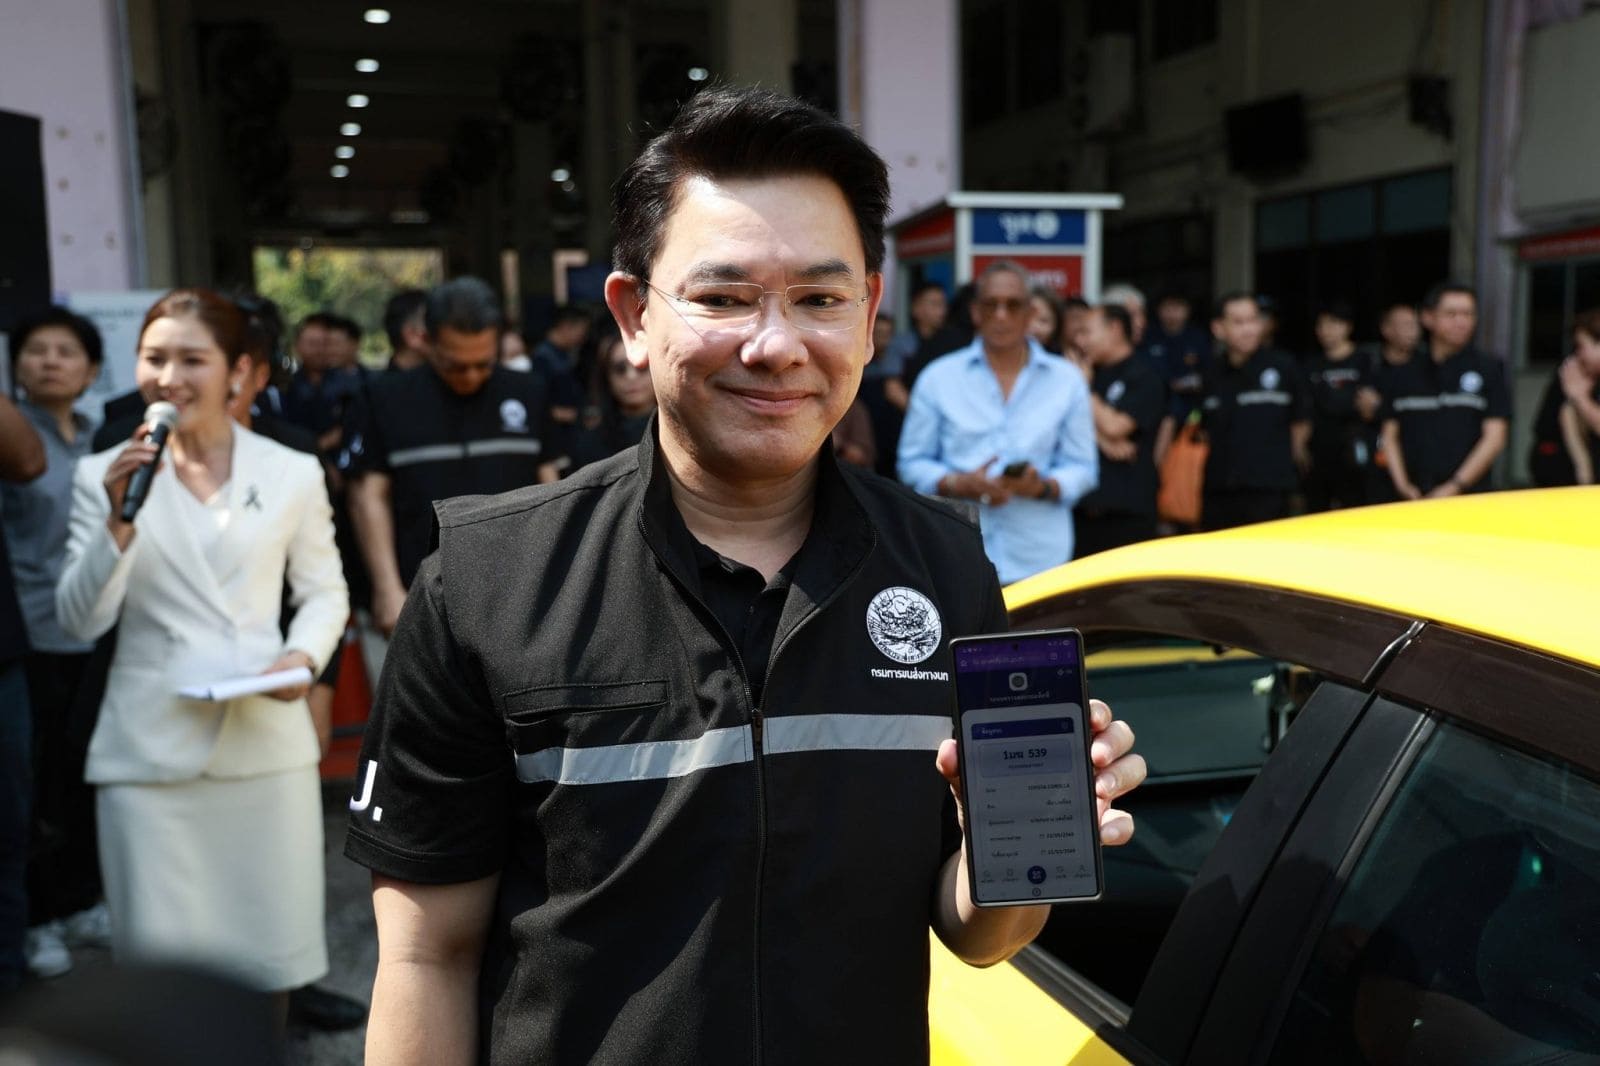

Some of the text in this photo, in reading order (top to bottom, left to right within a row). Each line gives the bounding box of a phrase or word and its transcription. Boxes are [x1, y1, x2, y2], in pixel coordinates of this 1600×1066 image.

[871, 666, 949, 682] กรมการขนส่งทางบก
[1028, 748, 1047, 758] 539
